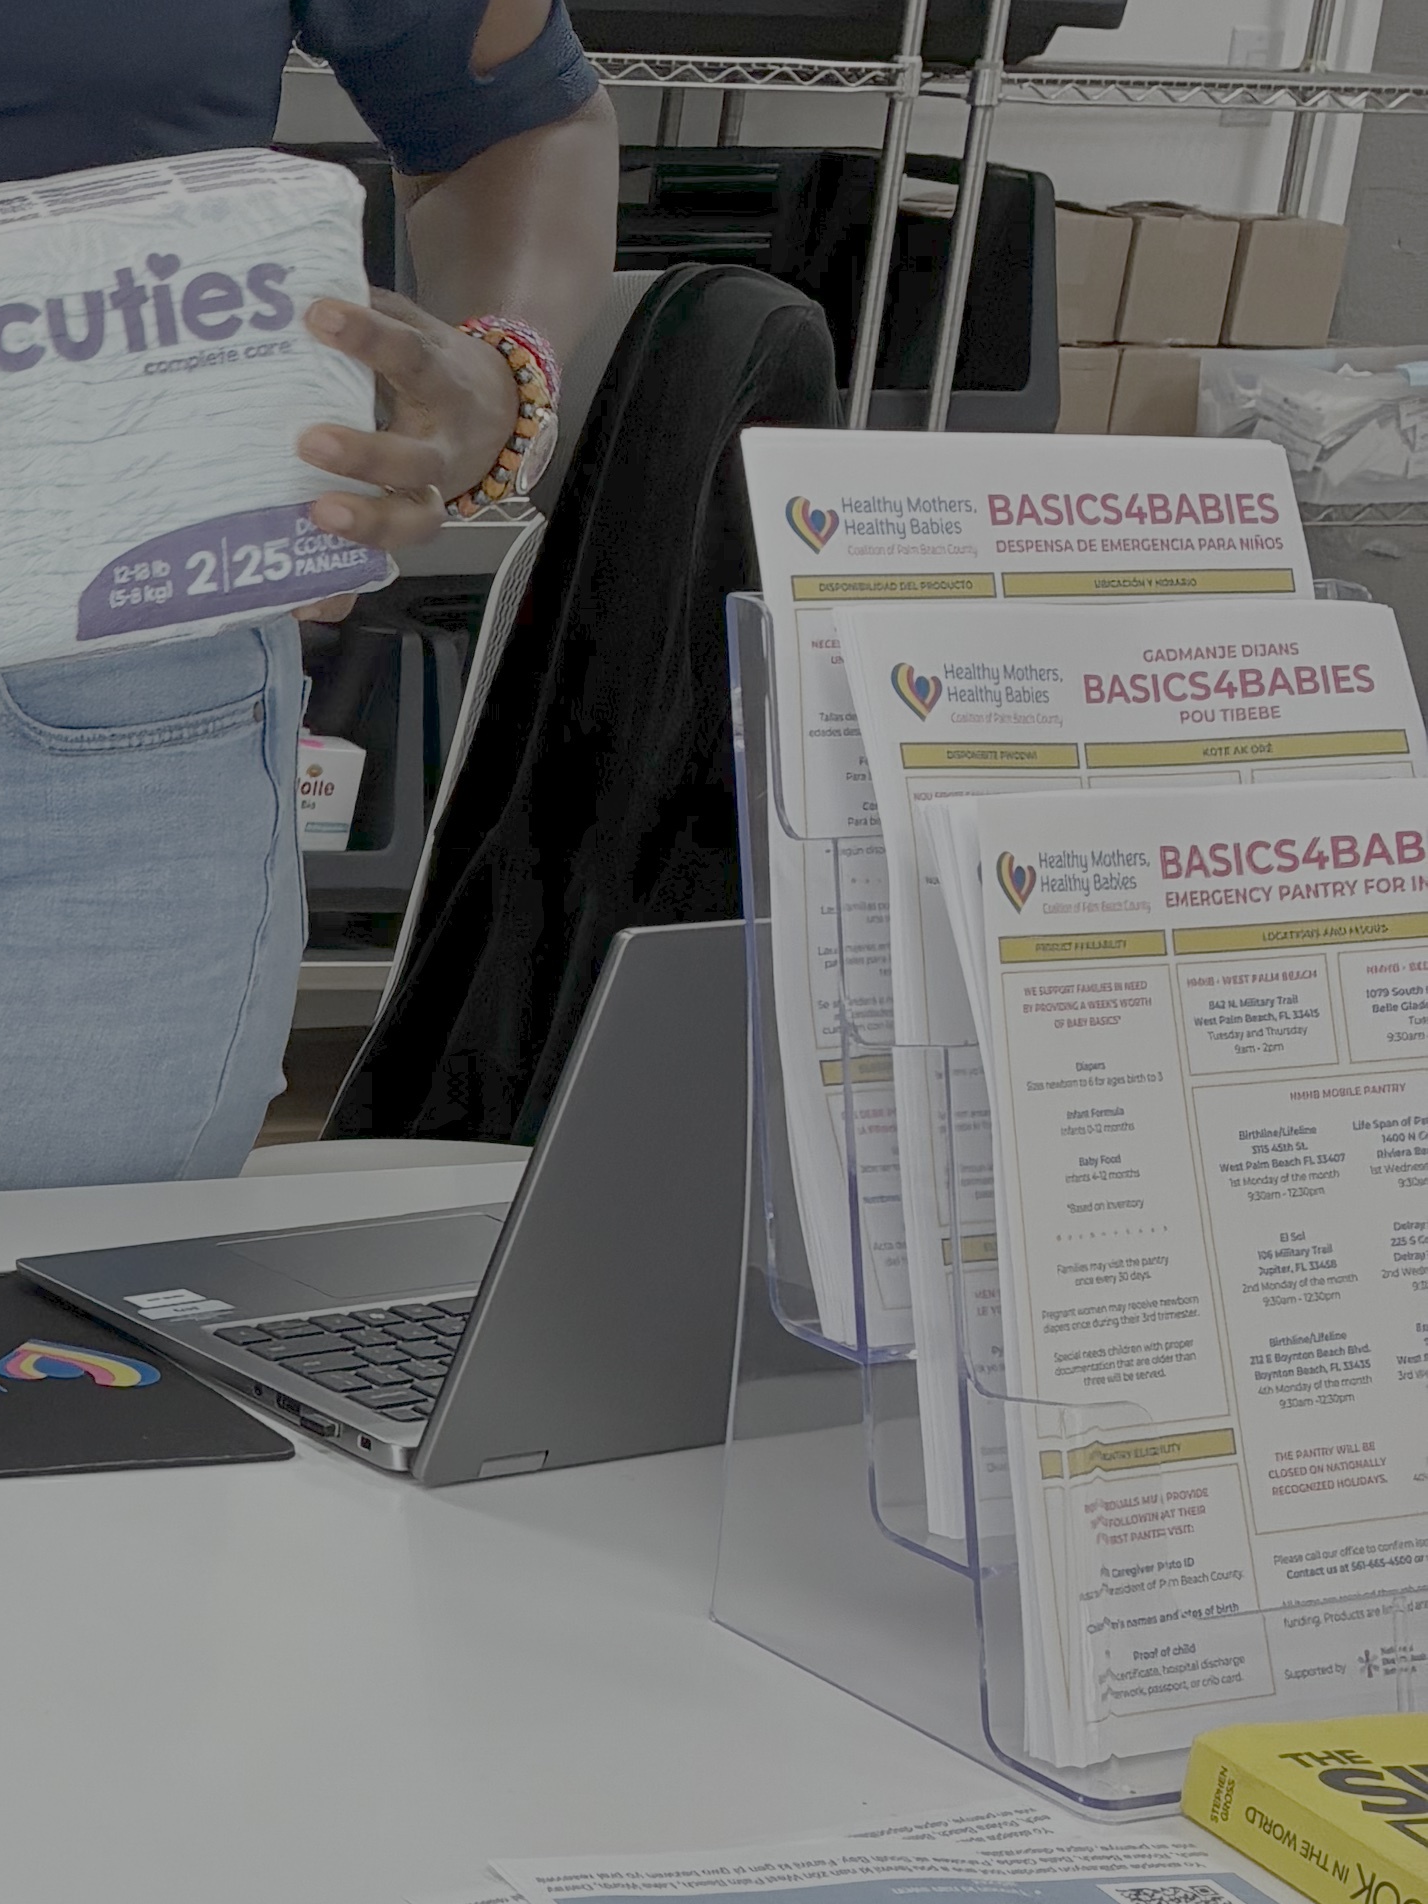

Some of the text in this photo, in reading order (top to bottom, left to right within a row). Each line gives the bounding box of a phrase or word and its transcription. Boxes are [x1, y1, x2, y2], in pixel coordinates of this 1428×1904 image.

[144, 340, 292, 377] complete care
[841, 496, 978, 518] Healthy Mothers,
[987, 492, 1280, 527] BASICS4BABIES
[845, 518, 963, 540] Healthy Babies
[995, 533, 1284, 554] DESPENSA DE EMERGENCIA PARA NIÑOS
[184, 537, 293, 595] 2 25
[899, 581, 919, 592] DEL
[920, 579, 973, 592] PRODUCTO
[1142, 642, 1300, 663] GADMANJE DIJANS
[943, 662, 1064, 686] Healthy Mothers,
[1083, 663, 1376, 705] BASICS4BABIES
[947, 685, 1051, 708] Healthy Babies
[1179, 704, 1282, 725] POU TIBEBE
[296, 777, 335, 797] olle
[1038, 849, 1151, 873] Healthy Mothers,
[1040, 872, 1137, 897] Healthy Babies
[1165, 886, 1273, 908] EMERGENCY
[1277, 879, 1359, 902] PANTRY
[1363, 876, 1405, 895] FOR
[1246, 1027, 1264, 1039] and
[1322, 1082, 1407, 1099] MOBILE PANTRY
[1219, 1156, 1302, 1174] West Palm Beach
[1316, 1346, 1346, 1359] Beach
[1274, 1440, 1375, 1463] THE PANTRY WILL BE
[1268, 1456, 1387, 1480] CLOSED ON NATIONALLY
[1271, 1479, 1335, 1497] RECOGNIZED
[1273, 1553, 1304, 1566] Please
[1304, 1550, 1321, 1562] call
[1286, 1566, 1325, 1580] Contact
[1278, 1749, 1373, 1769] THE
[1210, 1765, 1229, 1824] STEPHEN
[1220, 1778, 1237, 1823] GROSS
[1244, 1804, 1298, 1852] WORLD
[1299, 1839, 1330, 1874] THE
[1331, 1860, 1350, 1885] IN
